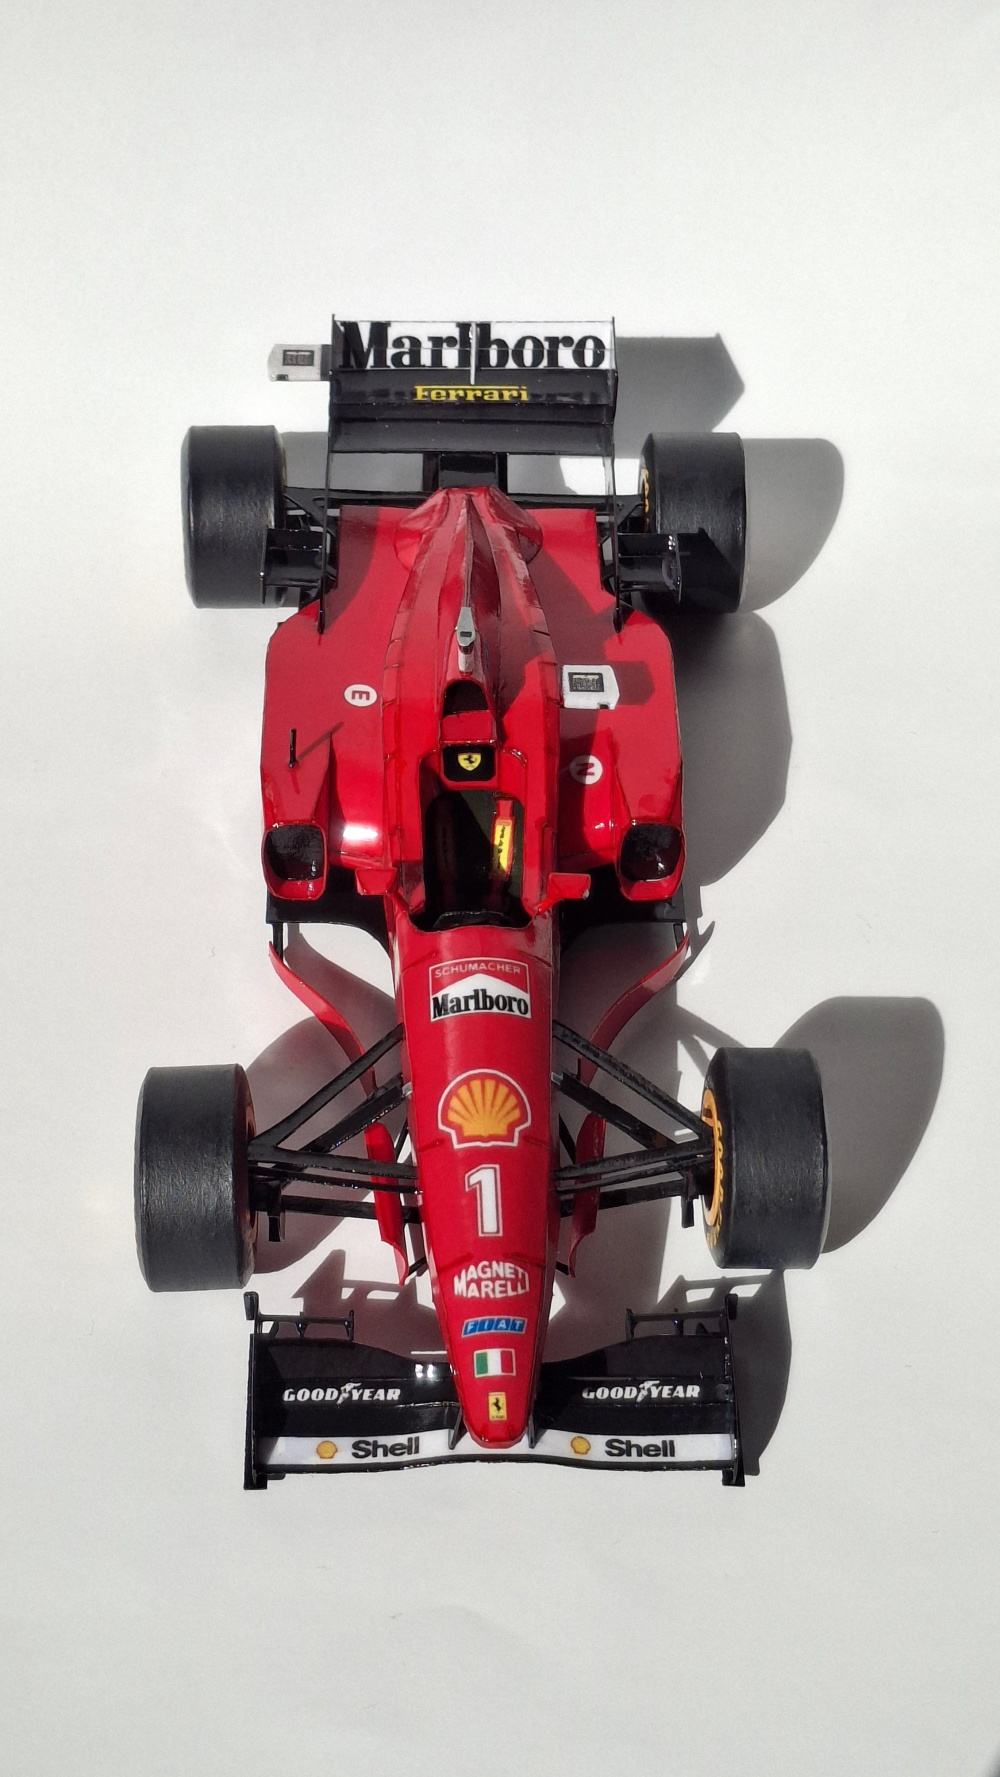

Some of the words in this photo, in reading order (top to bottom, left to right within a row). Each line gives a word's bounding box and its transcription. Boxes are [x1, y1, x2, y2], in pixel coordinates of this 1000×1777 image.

[339, 321, 606, 368] Marlboro
[413, 385, 529, 401] Ferrari
[351, 690, 370, 700] E
[434, 960, 522, 979] SCHUMACHER
[432, 988, 528, 1019] Marlboro
[464, 1163, 504, 1238] 1
[466, 1319, 523, 1334] FIAT
[351, 1436, 420, 1459] Shell
[604, 1438, 676, 1458] Shell
